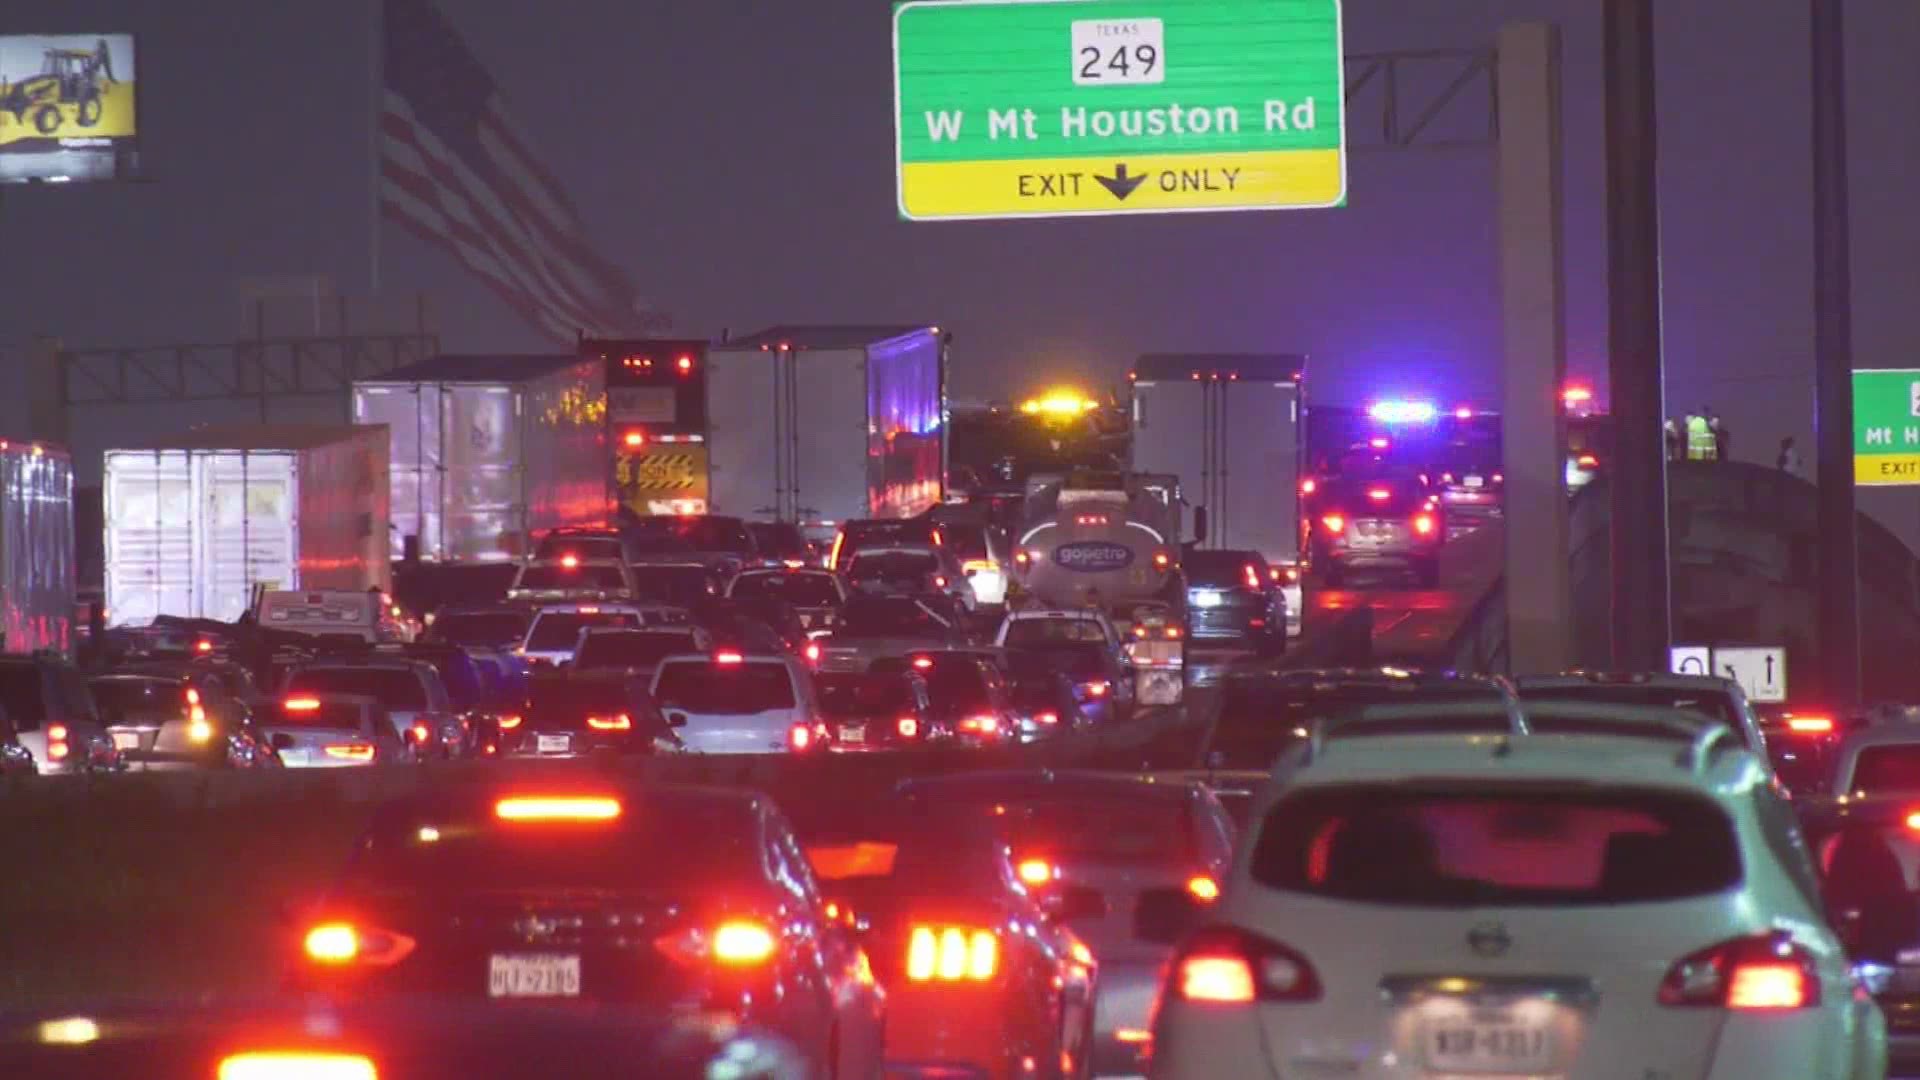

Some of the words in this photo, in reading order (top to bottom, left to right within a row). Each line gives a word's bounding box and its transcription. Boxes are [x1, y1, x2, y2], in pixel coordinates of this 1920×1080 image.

[1096, 23, 1140, 37] TEXAS
[1079, 44, 1158, 79] 249
[925, 109, 963, 142] W
[987, 107, 1038, 140] Mt
[1061, 102, 1240, 138] Houston
[1263, 97, 1316, 131] Rd
[1018, 172, 1083, 197] EXIT
[1159, 167, 1241, 192] ONLY
[1866, 426, 1892, 446] Mt
[1880, 462, 1917, 474] EXIT
[1060, 546, 1127, 564] gopetro
